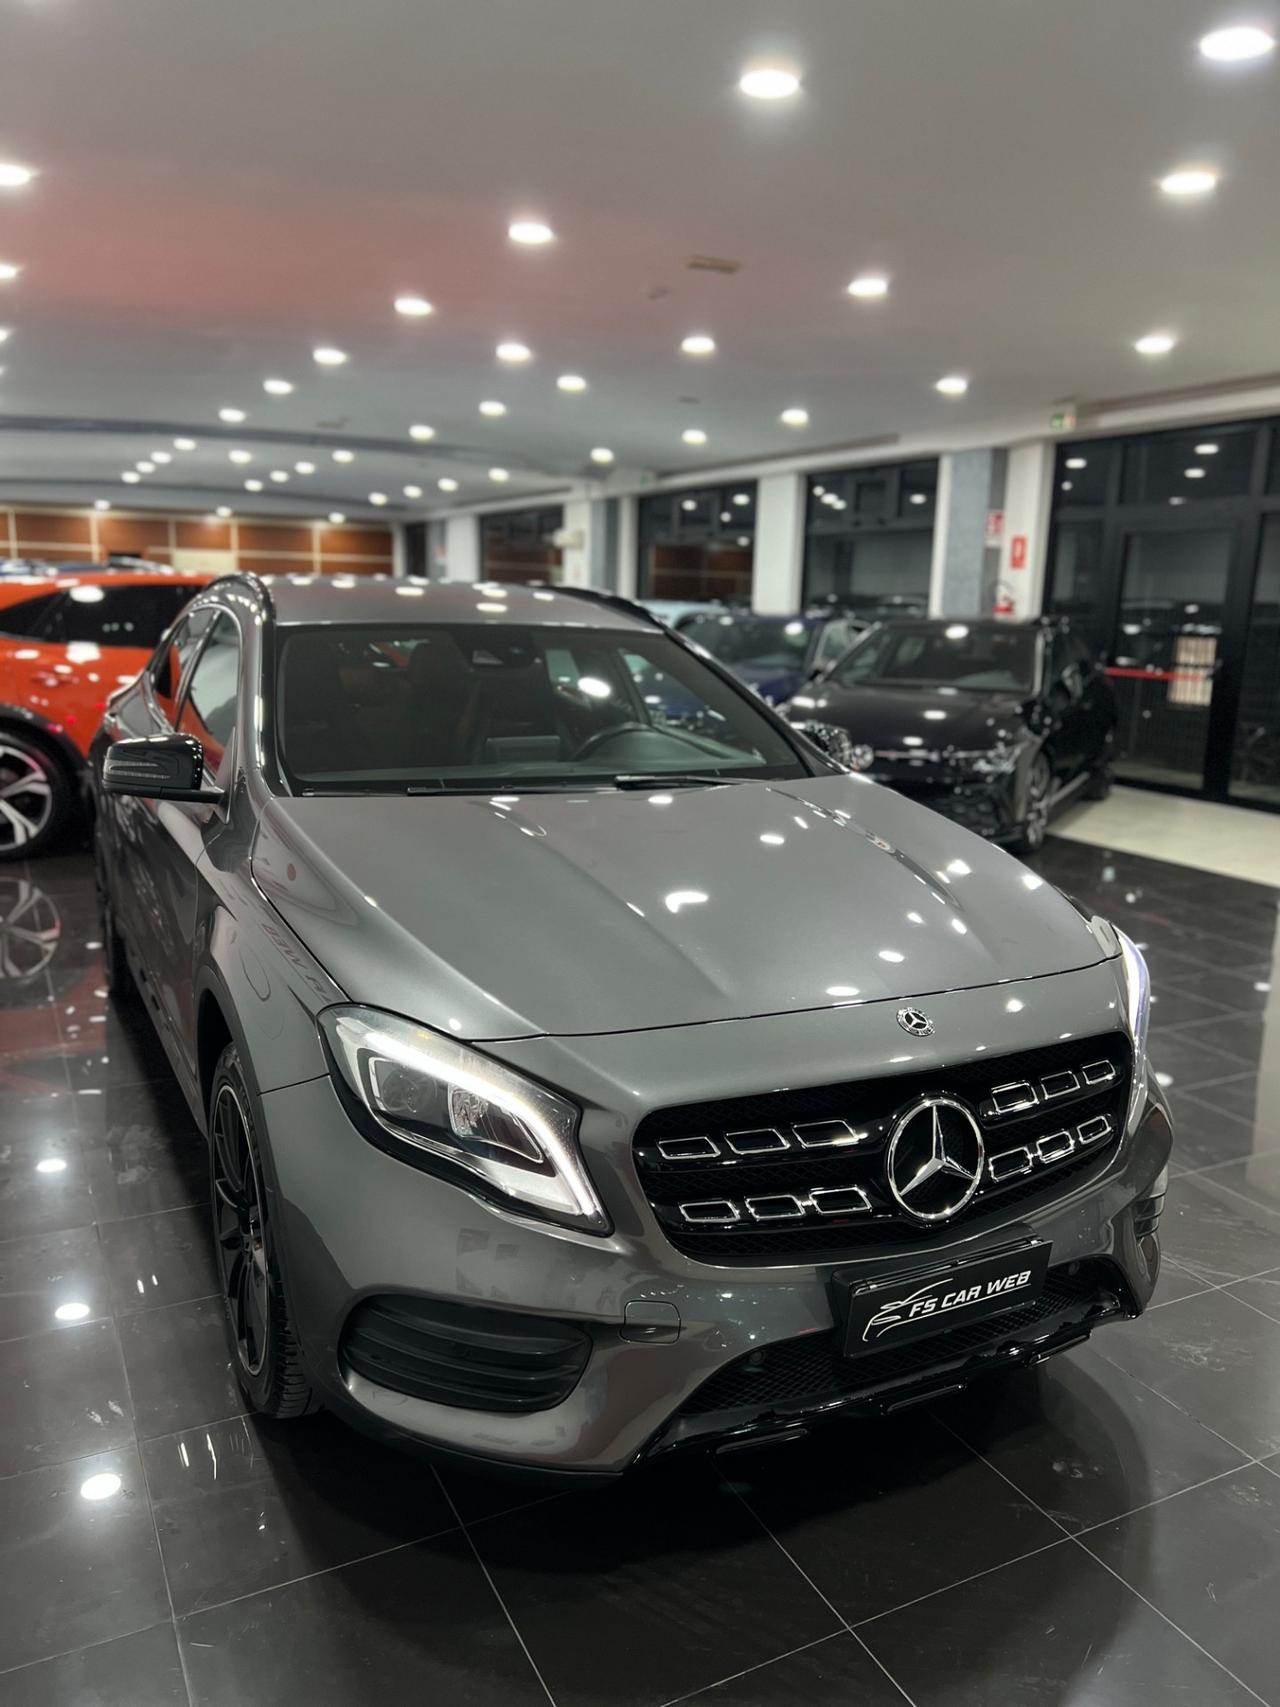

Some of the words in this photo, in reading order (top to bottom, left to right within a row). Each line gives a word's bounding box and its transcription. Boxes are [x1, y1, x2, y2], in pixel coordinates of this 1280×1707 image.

[909, 1298, 938, 1317] FS
[942, 1285, 982, 1308] CAR
[987, 1270, 1032, 1294] WEB
